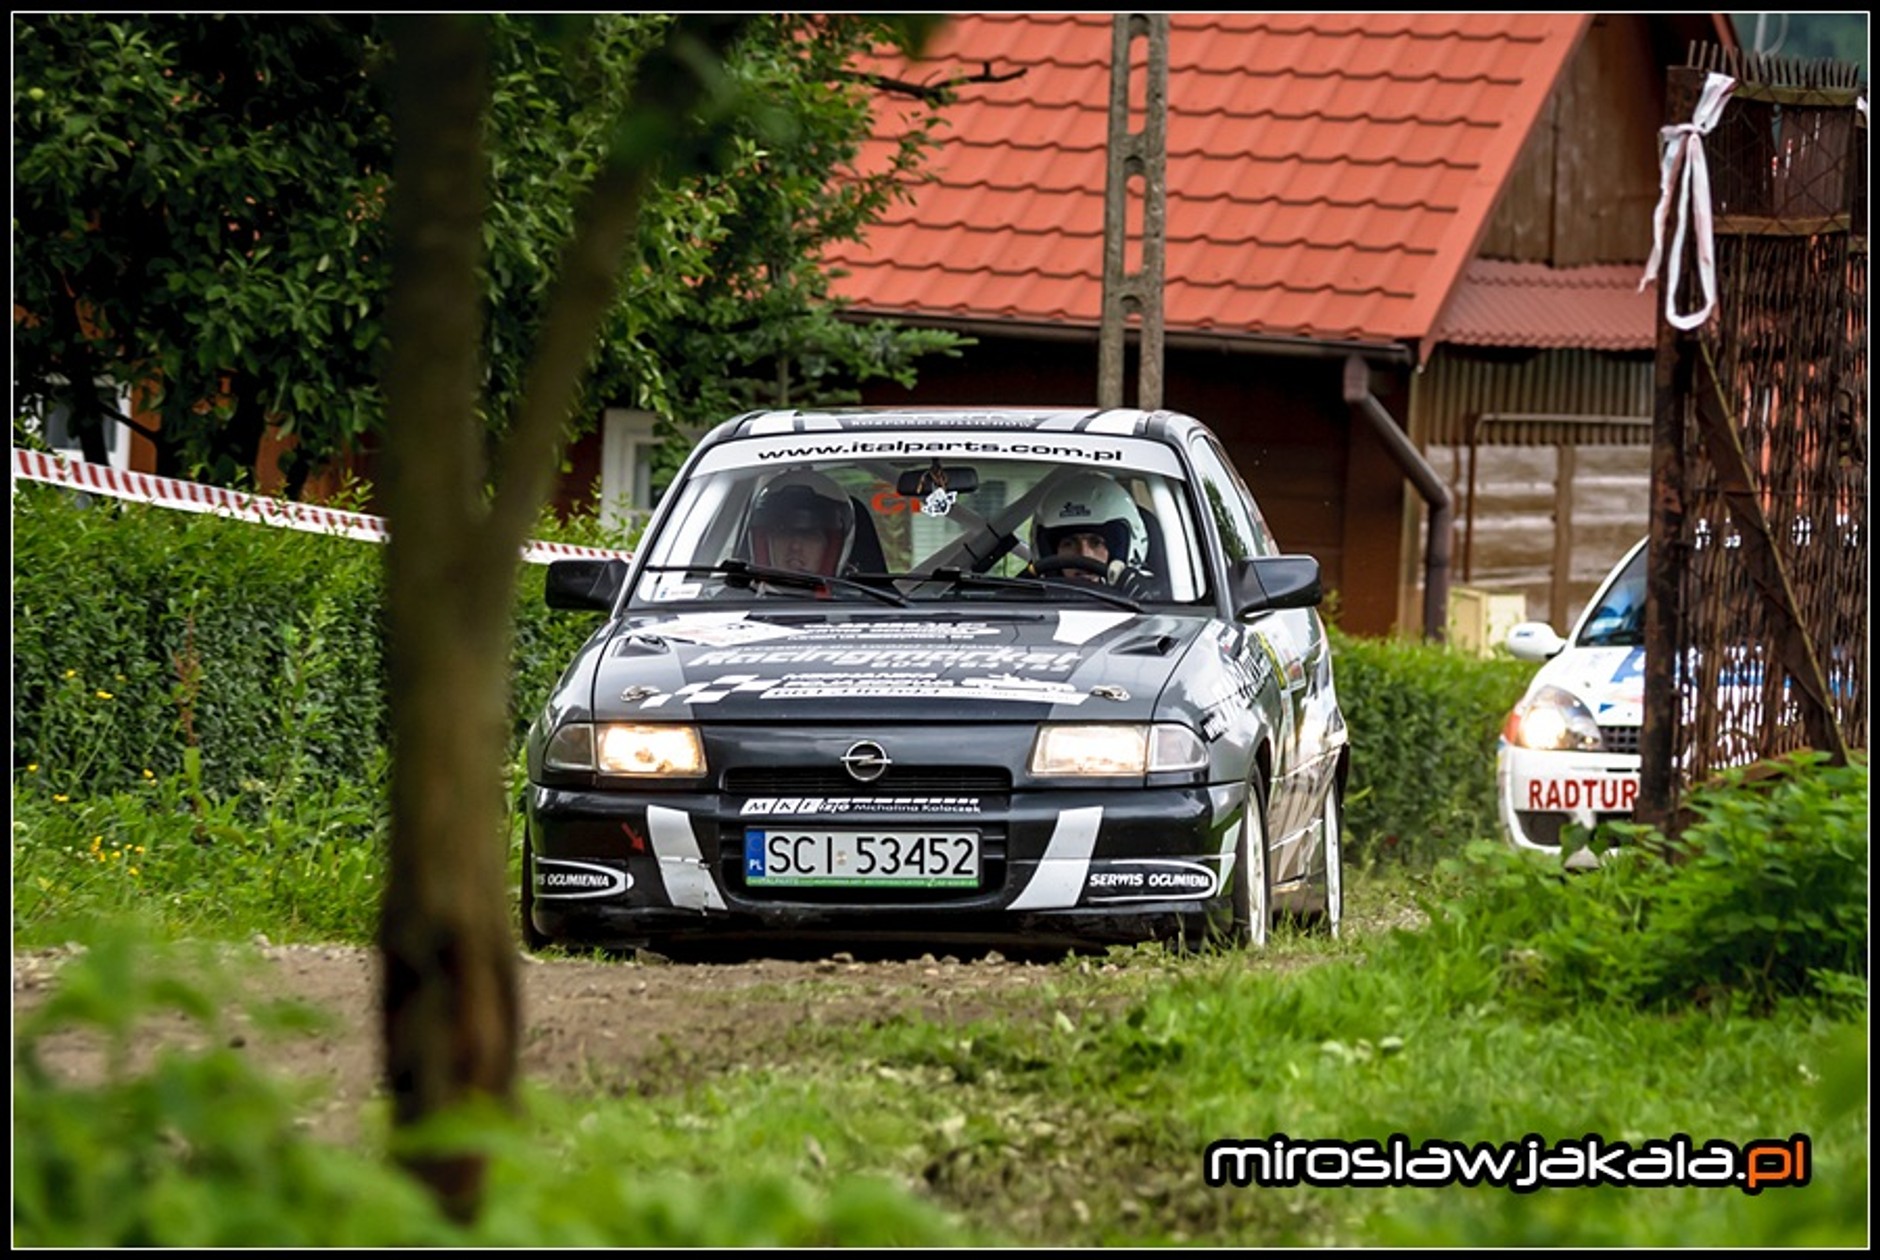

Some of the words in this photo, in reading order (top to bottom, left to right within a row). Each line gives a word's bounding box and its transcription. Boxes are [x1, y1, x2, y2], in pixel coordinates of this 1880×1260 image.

[757, 440, 1123, 461] www.italparts.com.pl
[1529, 778, 1638, 810] RADTUR
[854, 803, 919, 813] Michalina
[749, 859, 762, 870] PL
[768, 836, 833, 875] SCI
[855, 836, 975, 875] 53452
[1089, 872, 1144, 887] SERWIS
